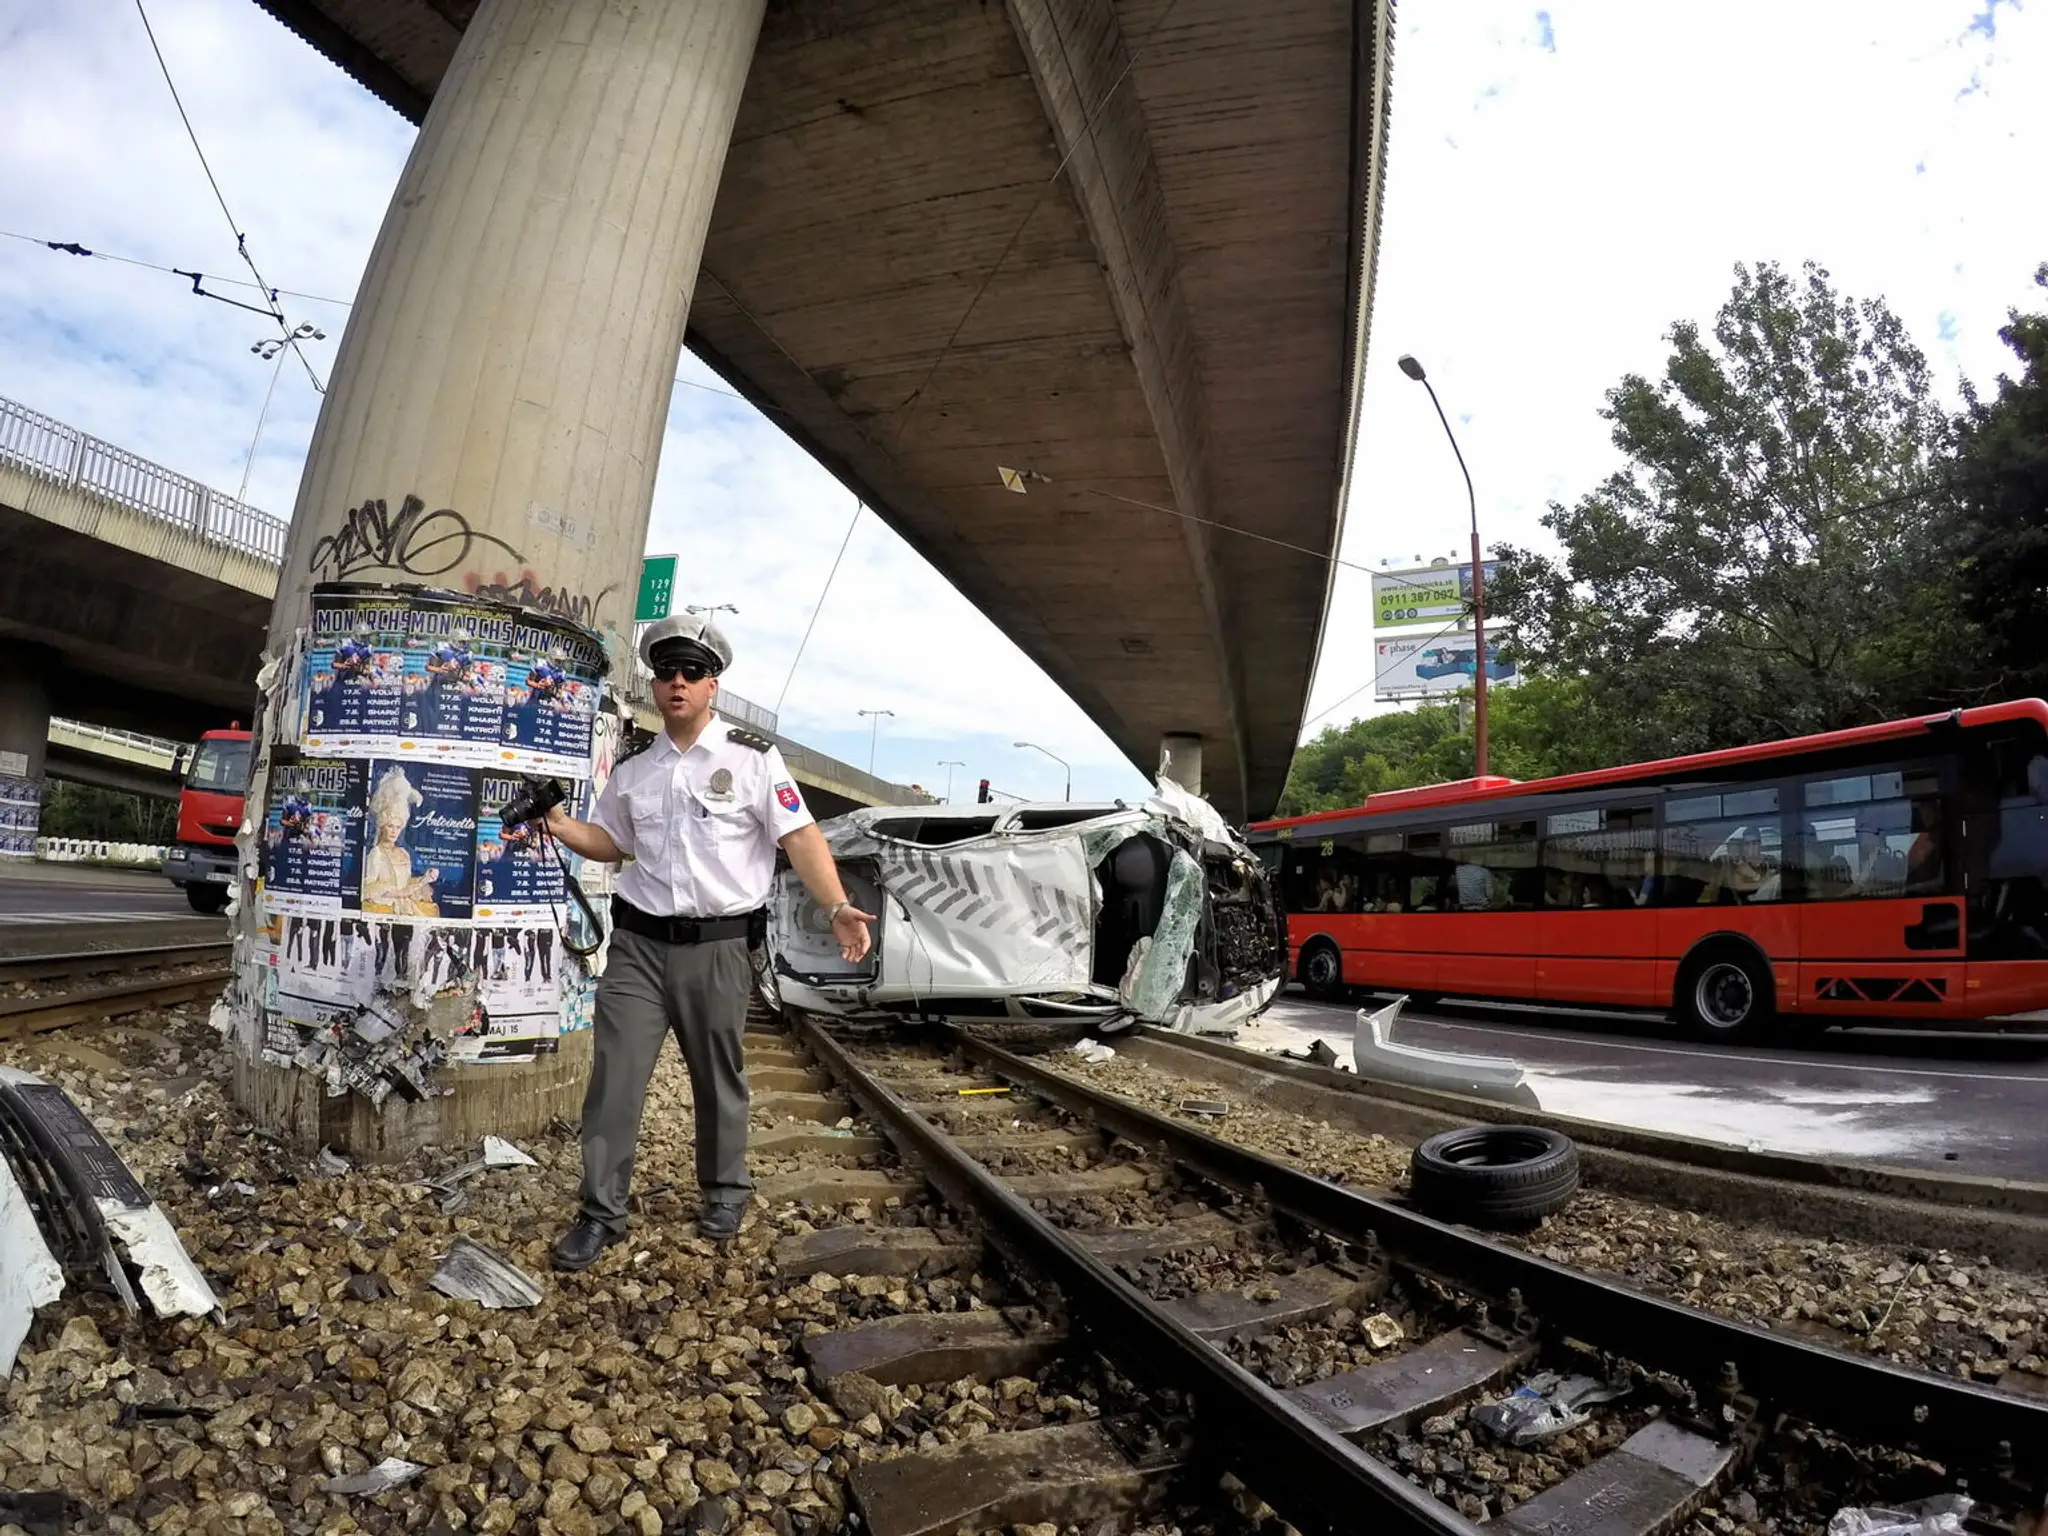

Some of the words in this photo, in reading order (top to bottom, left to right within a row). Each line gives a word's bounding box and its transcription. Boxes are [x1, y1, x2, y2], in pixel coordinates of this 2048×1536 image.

[651, 579, 670, 589] 129
[655, 592, 667, 602] 62
[1381, 593, 1407, 606] 0911
[1411, 592, 1431, 602] 387
[652, 605, 666, 615] 34
[317, 609, 410, 634] MONARCHS
[409, 611, 514, 644] MONARCHS
[512, 624, 602, 666] MONARCHS
[467, 706, 503, 714] KNIGHT
[463, 725, 501, 733] PATRIOT
[1321, 842, 1333, 856] 28
